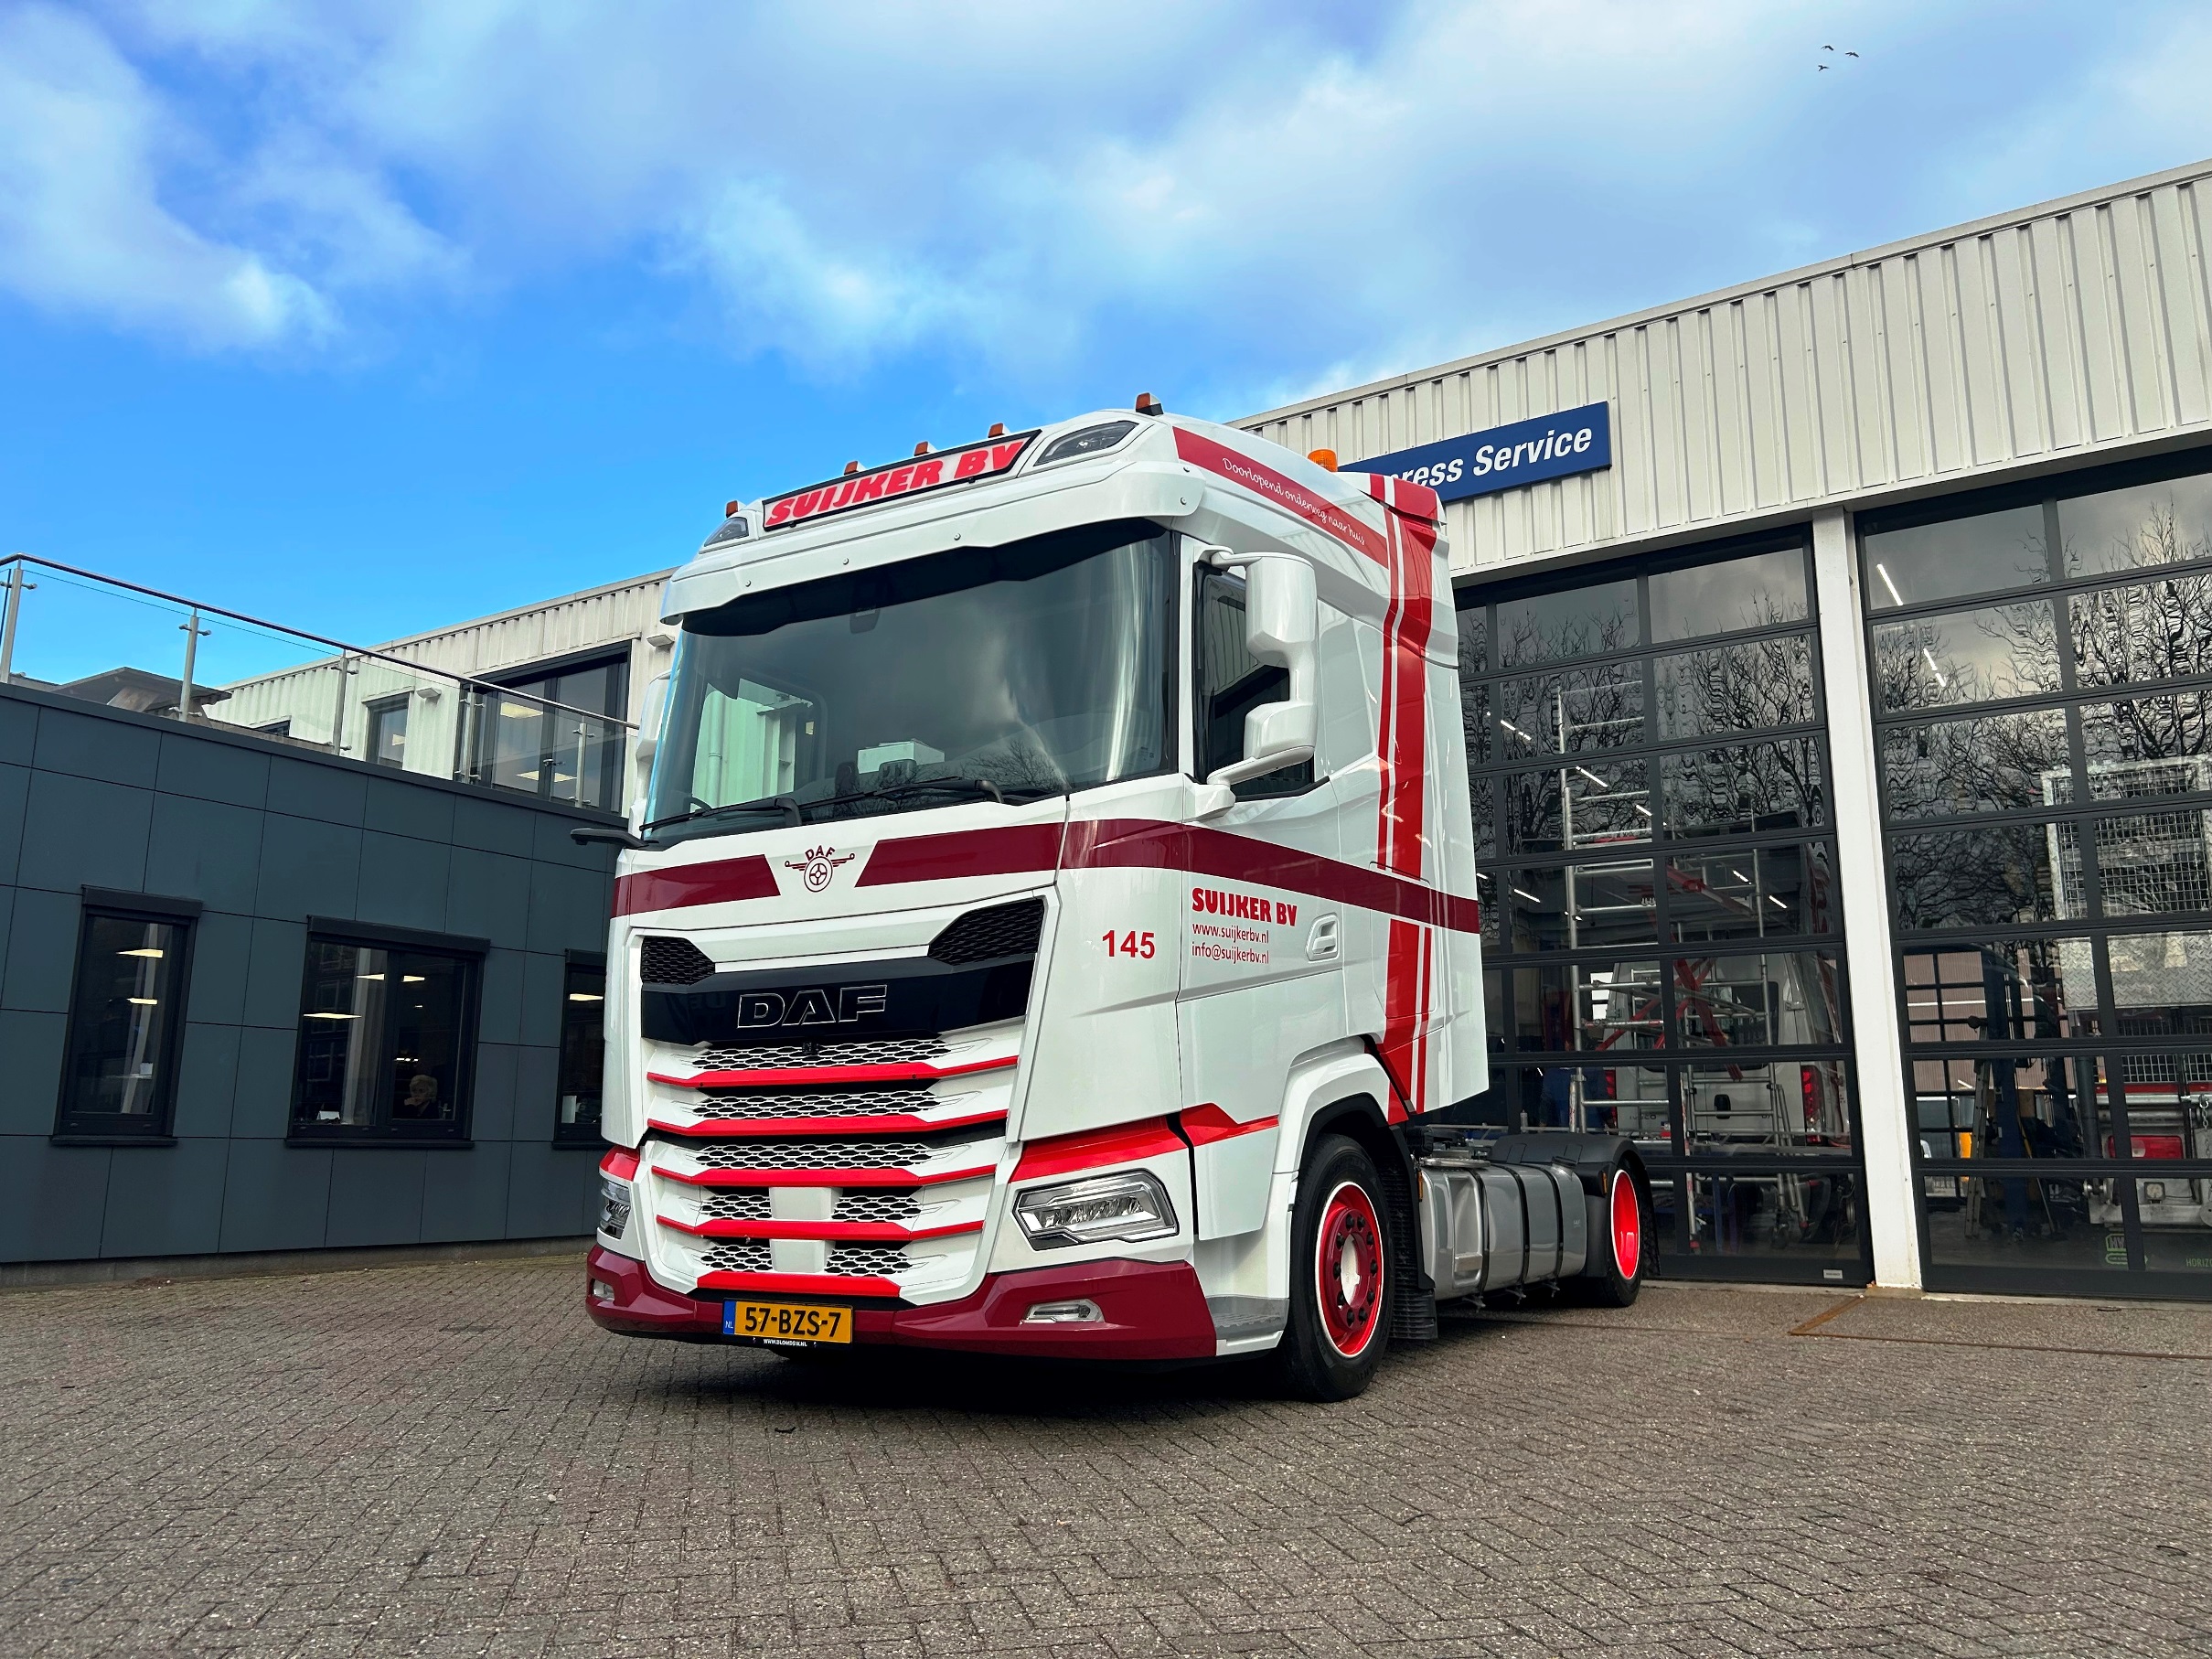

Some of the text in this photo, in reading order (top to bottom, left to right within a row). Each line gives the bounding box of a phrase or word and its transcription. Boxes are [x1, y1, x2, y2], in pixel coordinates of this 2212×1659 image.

[1472, 427, 1592, 476] Service
[765, 441, 1023, 527] SUIJKER BV
[1222, 457, 1284, 496] Doorlopend
[1285, 490, 1327, 524] onderweg
[1348, 523, 1365, 546] huis
[805, 845, 836, 861] DAF
[1191, 887, 1298, 926] SUIJKER BV
[1102, 929, 1156, 959] 145
[1191, 923, 1269, 944] www.suijkerbv.nl
[1191, 942, 1269, 964] info@suijkerbv.nl
[737, 985, 887, 1029] DAF
[744, 1306, 841, 1338] 57-BZS-7
